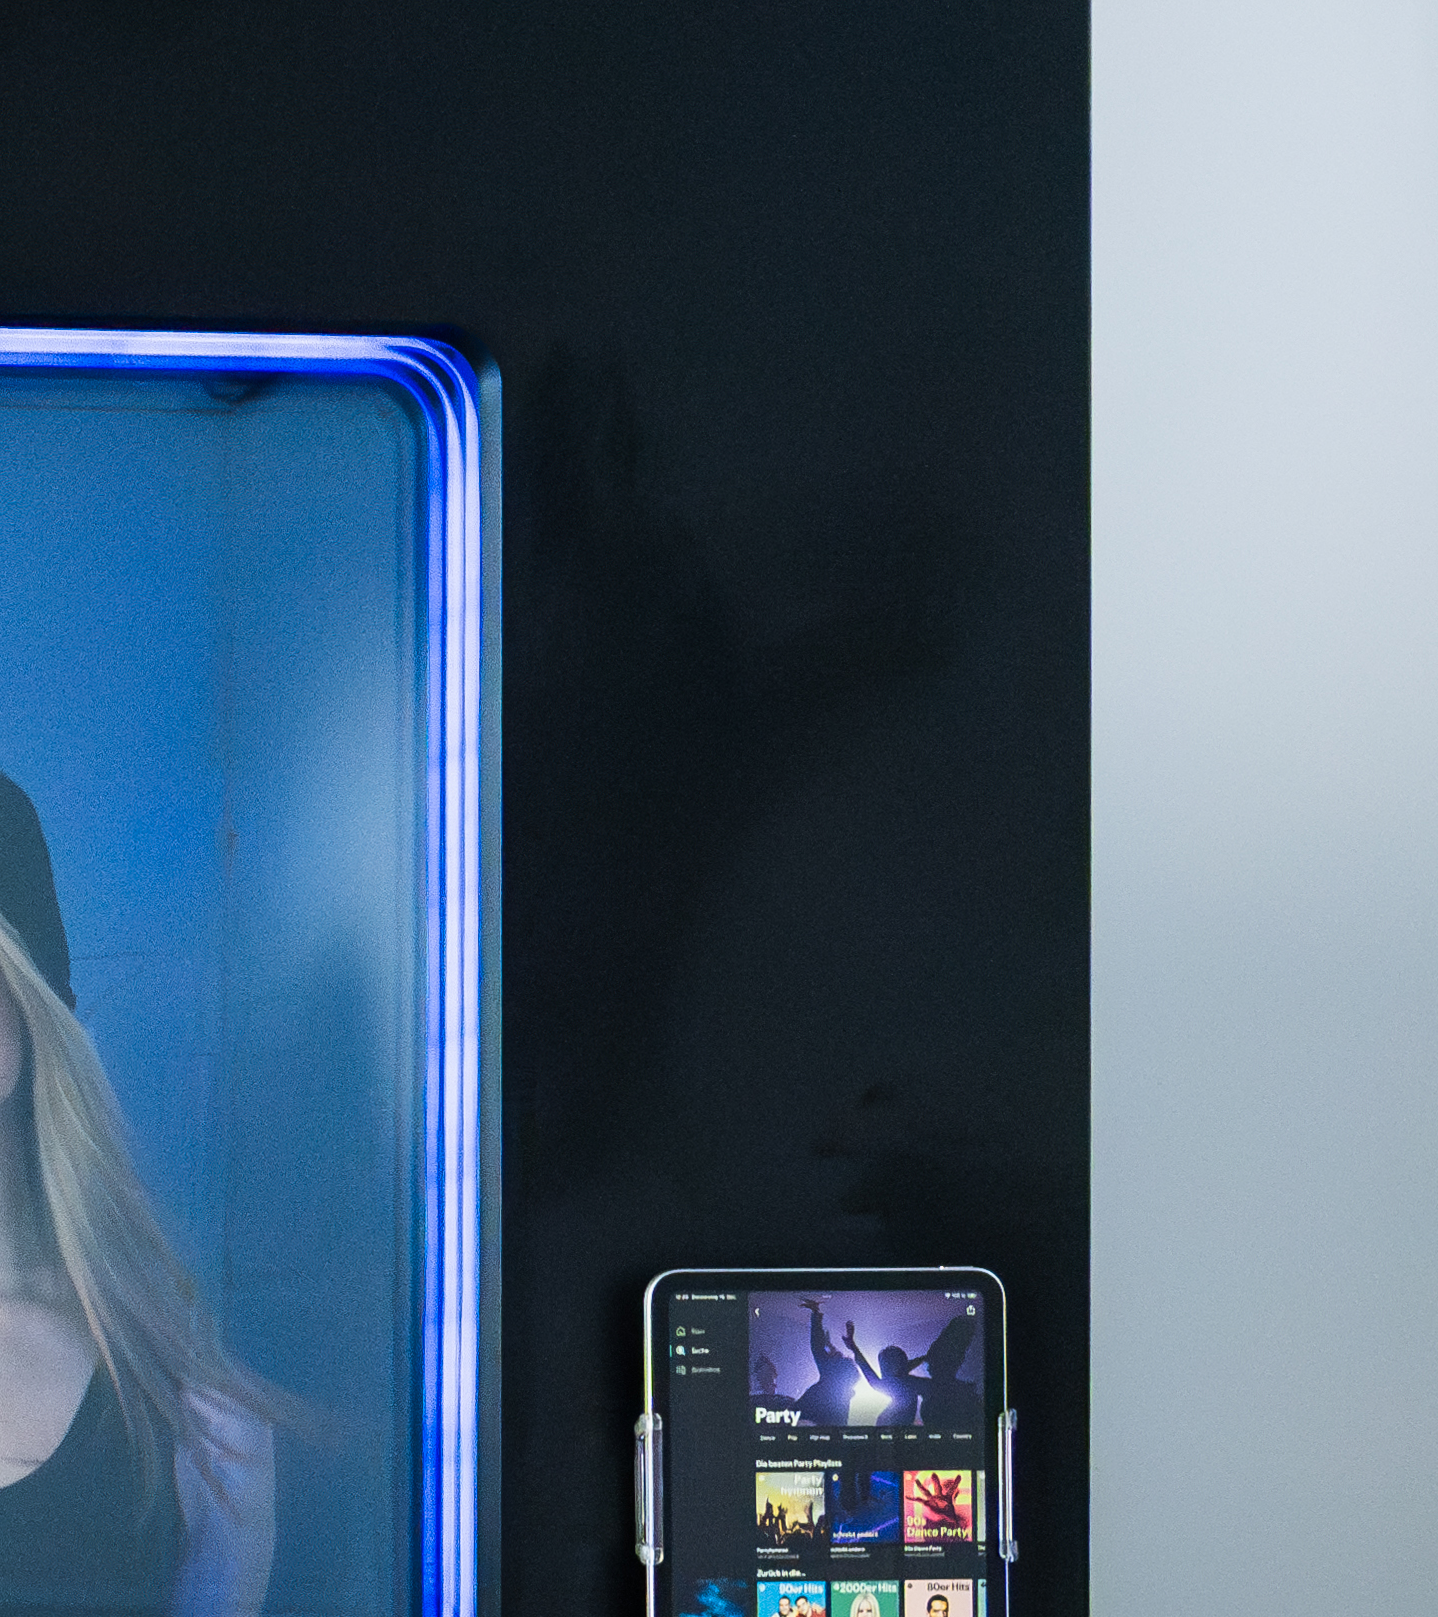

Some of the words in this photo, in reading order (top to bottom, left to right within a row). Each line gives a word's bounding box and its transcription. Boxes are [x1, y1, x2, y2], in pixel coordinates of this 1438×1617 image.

[755, 1407, 801, 1427] Party
[794, 1473, 823, 1486] Party
[906, 1527, 939, 1538] Dance
[940, 1526, 968, 1539] Party
[878, 1582, 897, 1593] Hits
[951, 1581, 970, 1591] Hits
